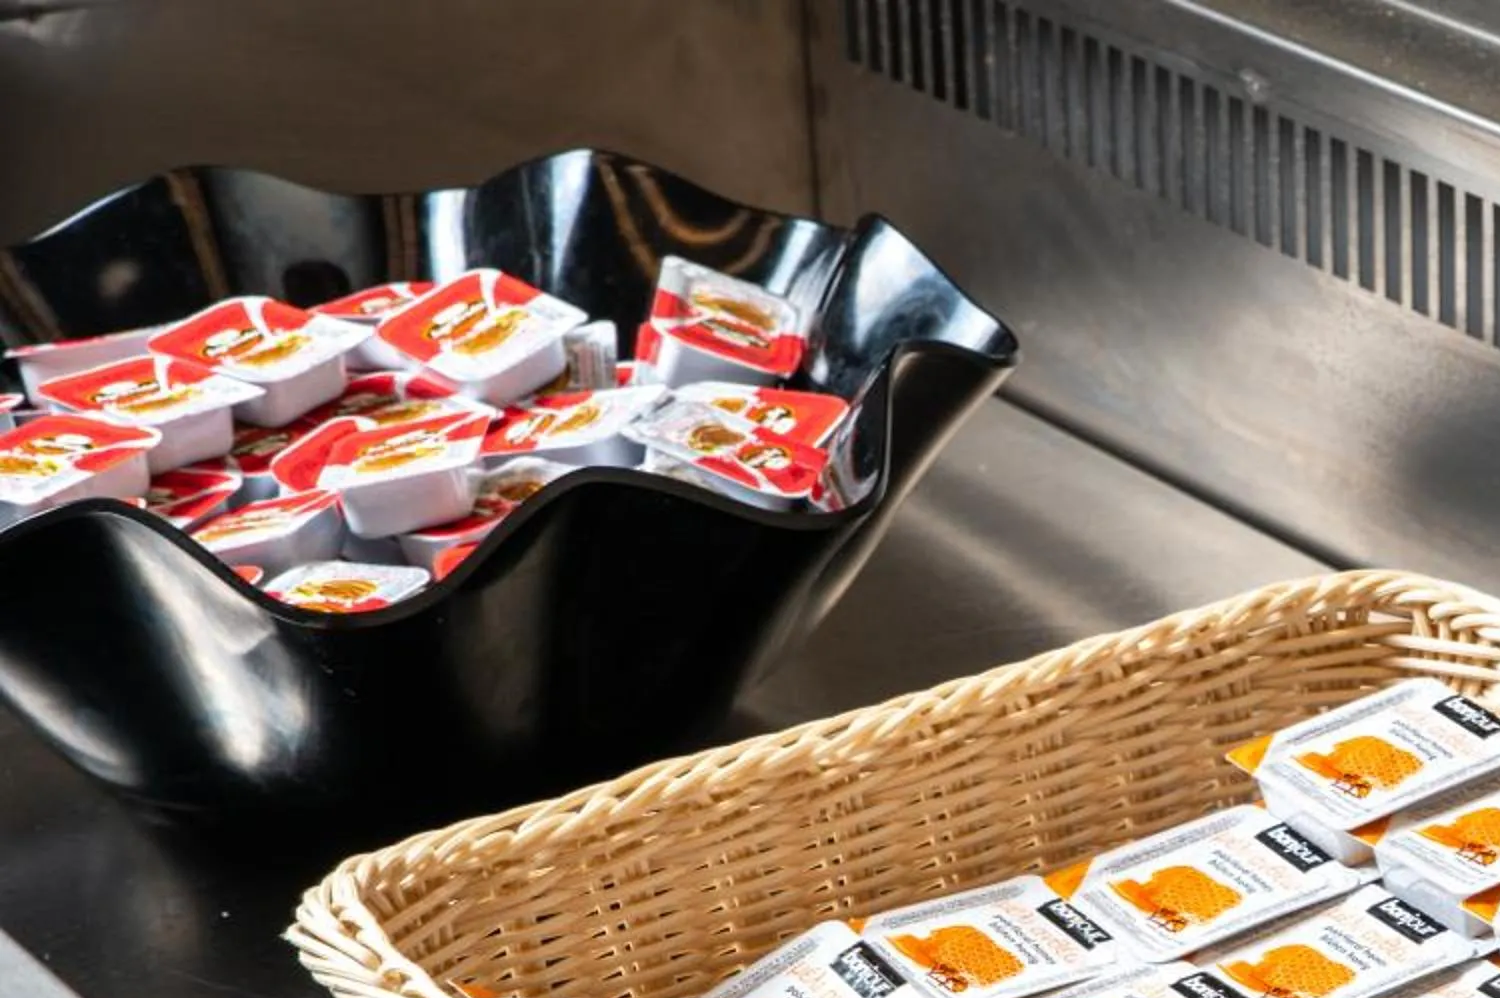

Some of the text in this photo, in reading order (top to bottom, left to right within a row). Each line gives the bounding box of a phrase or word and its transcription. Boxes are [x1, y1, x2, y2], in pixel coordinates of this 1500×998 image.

[1269, 826, 1324, 865] bonjour
[1049, 904, 1108, 943] bonjour
[1380, 900, 1437, 936] bonjour
[841, 948, 893, 997] bonjour
